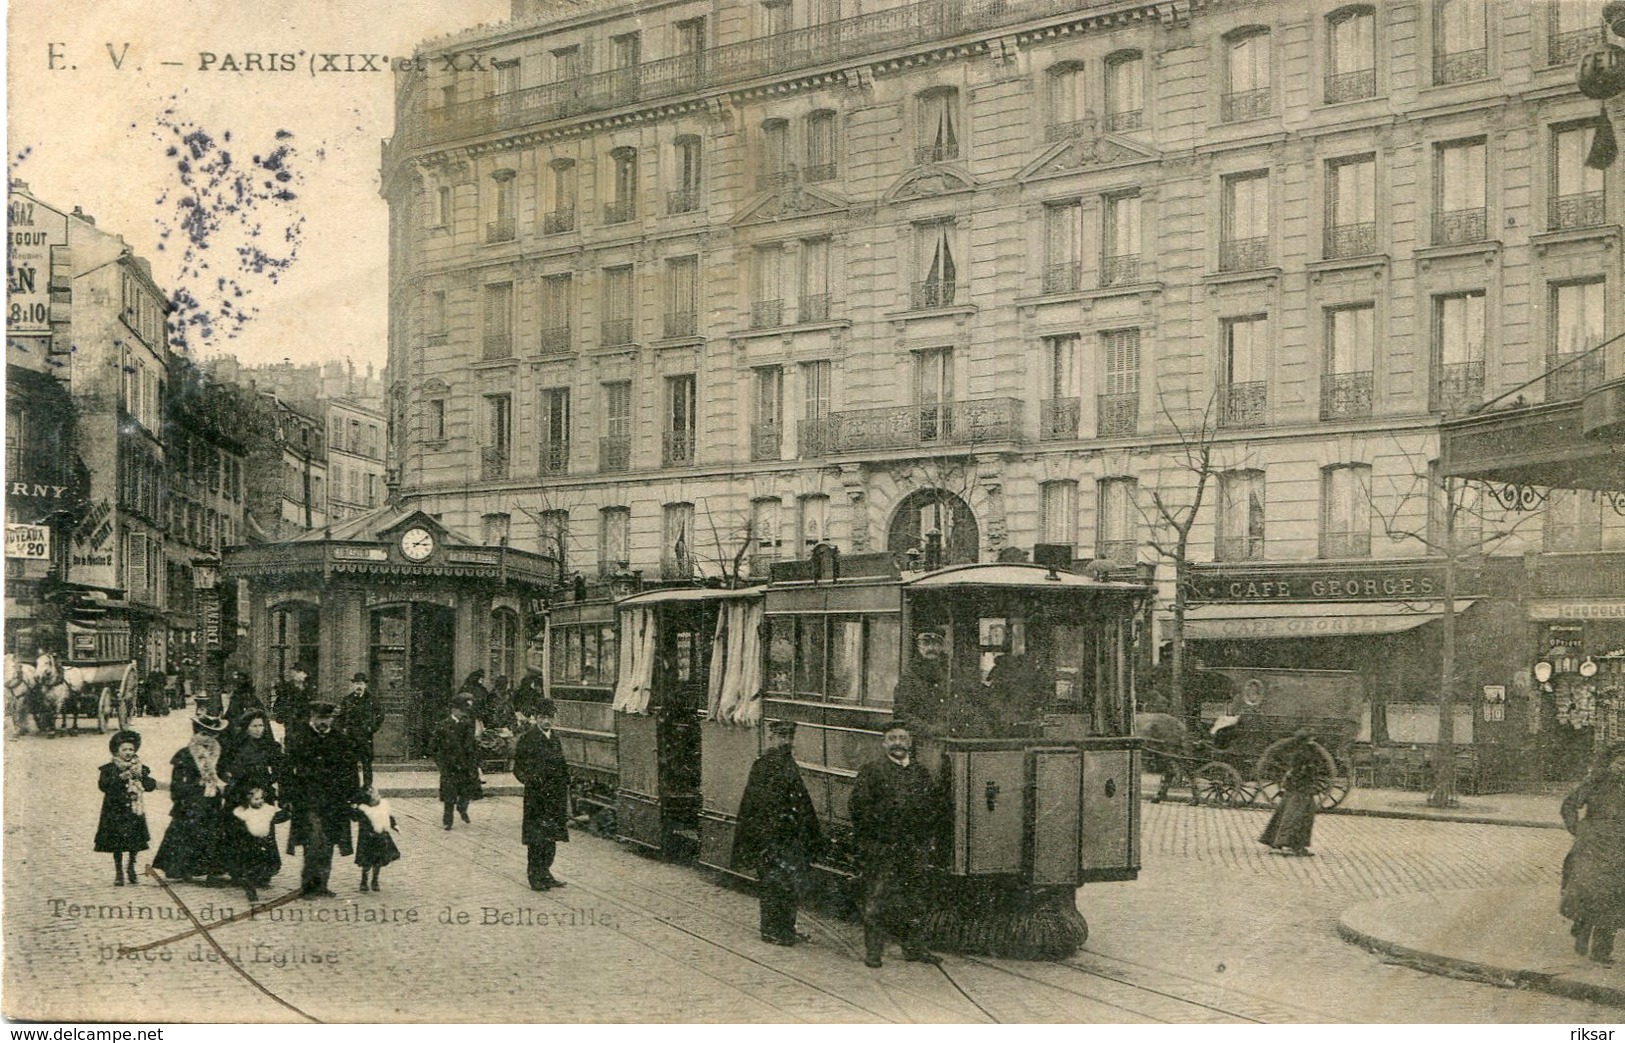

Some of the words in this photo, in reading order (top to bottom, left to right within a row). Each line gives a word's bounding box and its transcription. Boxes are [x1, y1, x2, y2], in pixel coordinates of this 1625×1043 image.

[5, 481, 69, 499] RNY
[1229, 582, 1291, 598] CAFE
[1311, 577, 1434, 596] GEORGES
